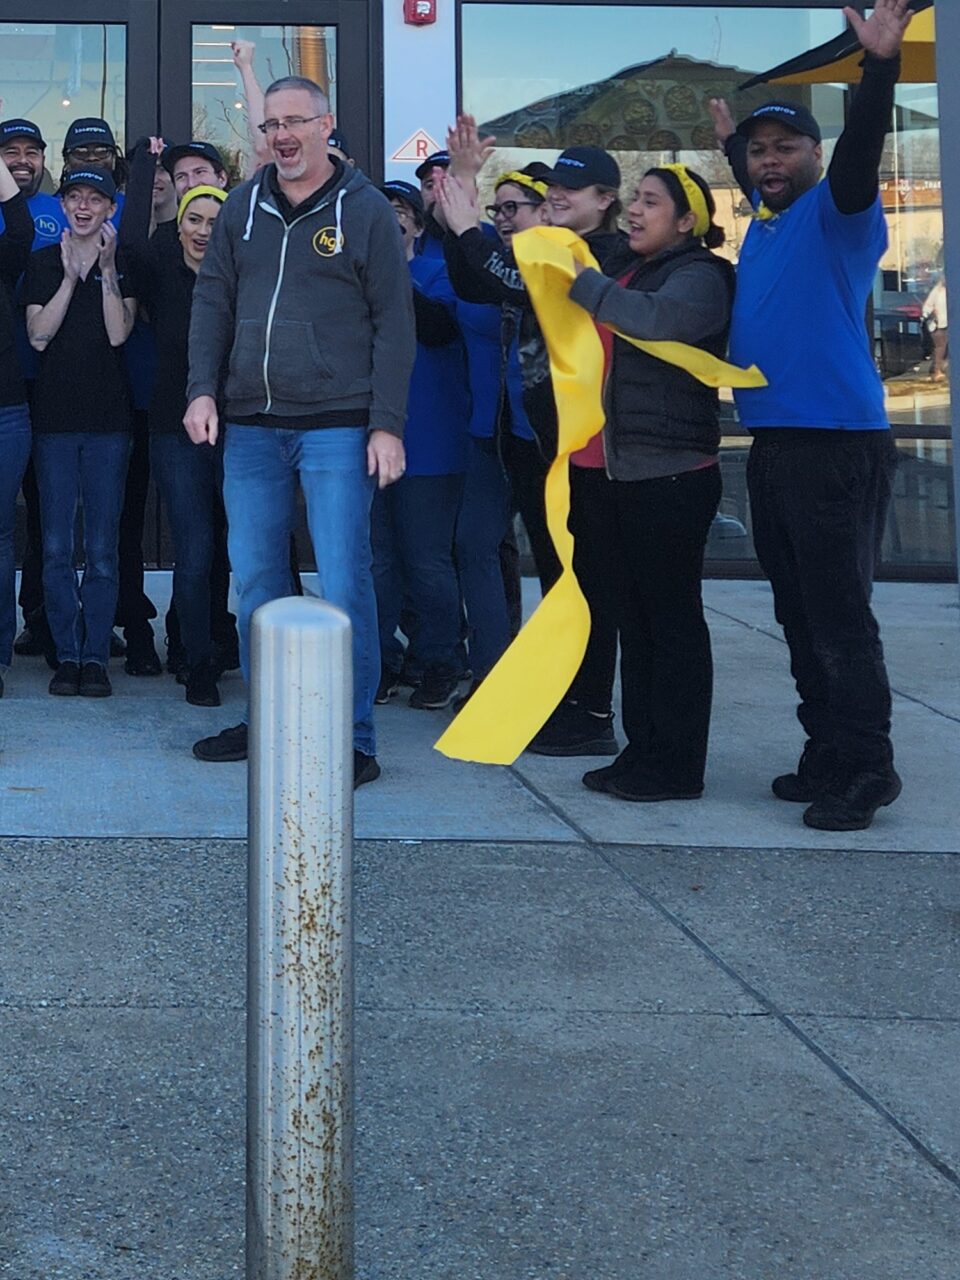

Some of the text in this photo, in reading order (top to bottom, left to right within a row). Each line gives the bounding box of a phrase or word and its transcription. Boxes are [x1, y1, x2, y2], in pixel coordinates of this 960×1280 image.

[415, 139, 428, 157] R
[39, 218, 56, 233] hg
[319, 231, 337, 252] hg
